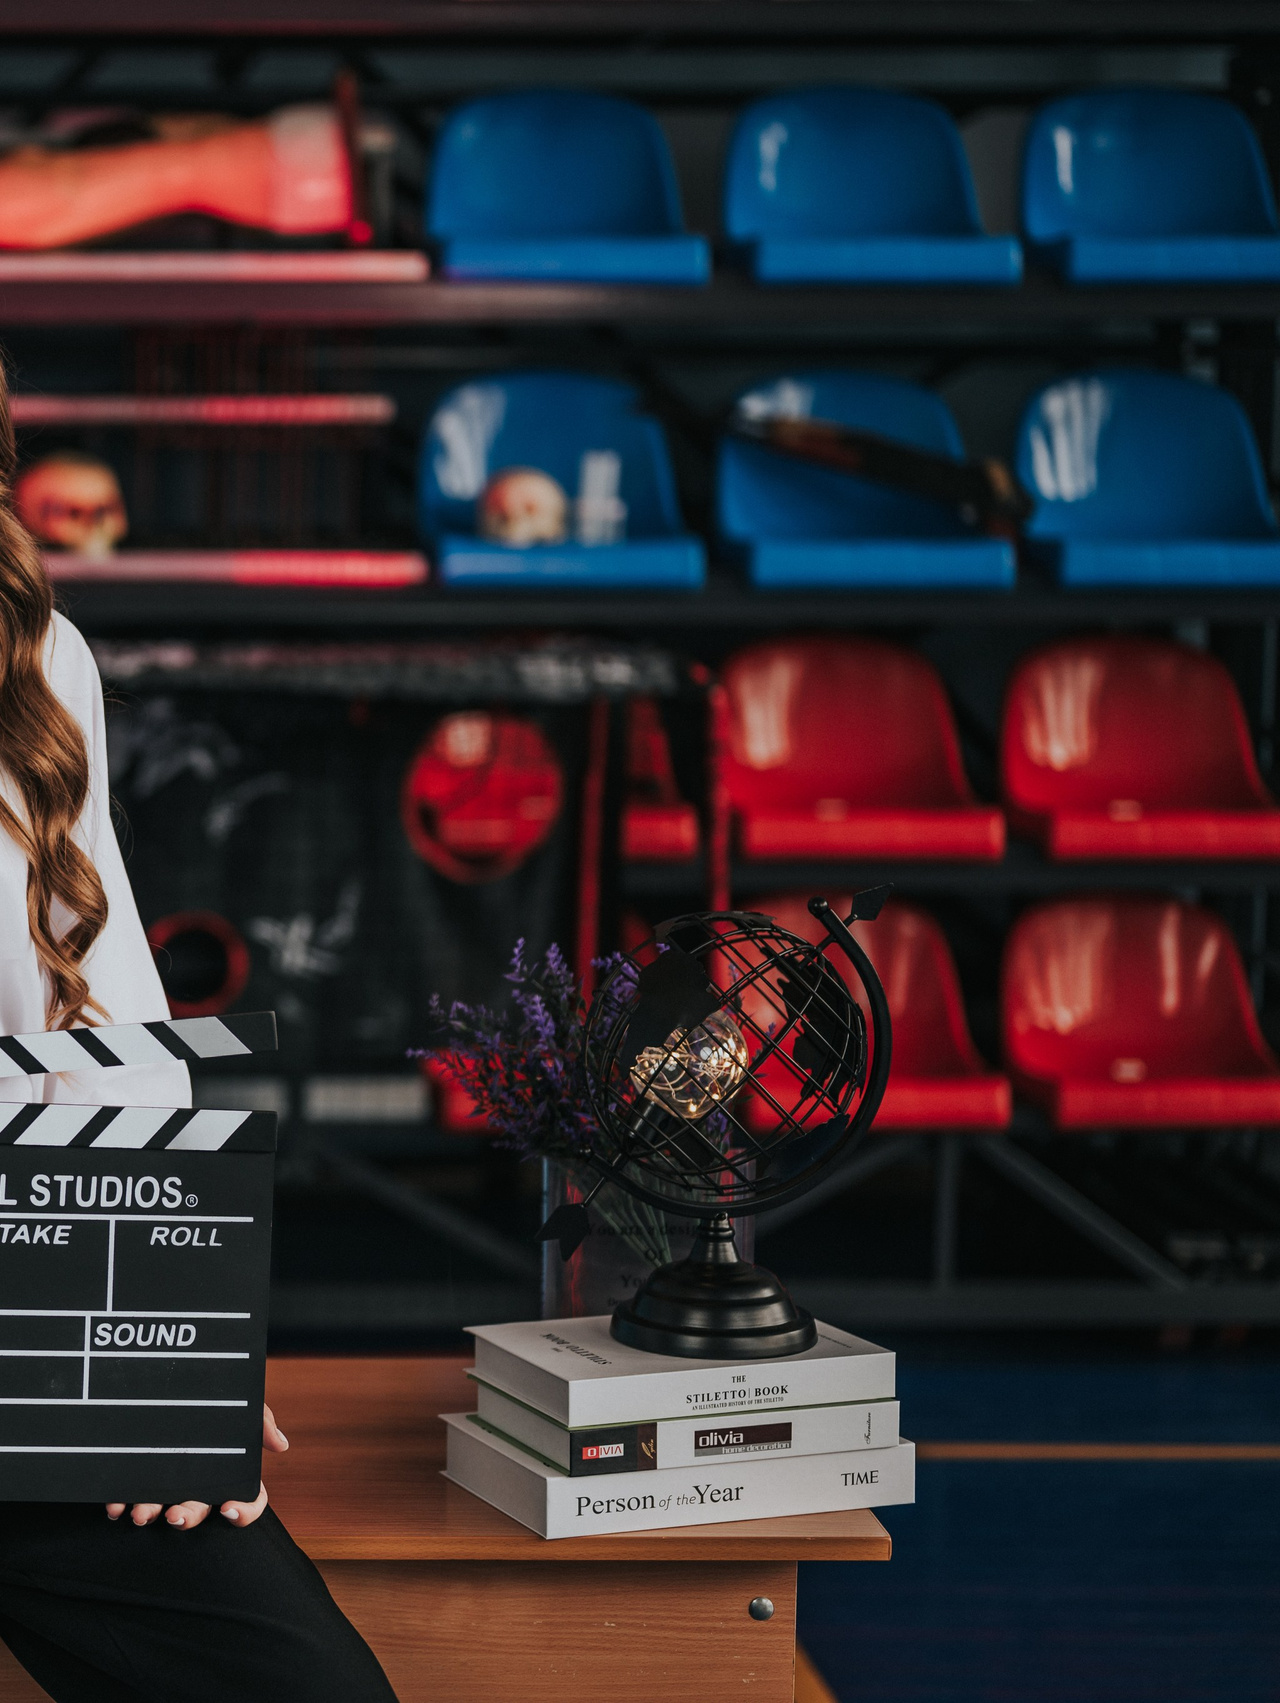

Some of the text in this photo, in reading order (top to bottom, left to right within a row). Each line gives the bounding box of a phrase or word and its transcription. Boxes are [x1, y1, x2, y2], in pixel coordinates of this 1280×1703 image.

[0, 1223, 73, 1245] TAKE
[149, 1226, 223, 1247] ROLL
[94, 1322, 197, 1347] SOUND
[731, 1374, 747, 1384] THE
[686, 1384, 789, 1404] STILETTO BOOK
[698, 1430, 744, 1447] olivia
[721, 1441, 790, 1455] home decoration
[840, 1469, 879, 1486] TIME
[576, 1483, 744, 1517] Person of the Year
